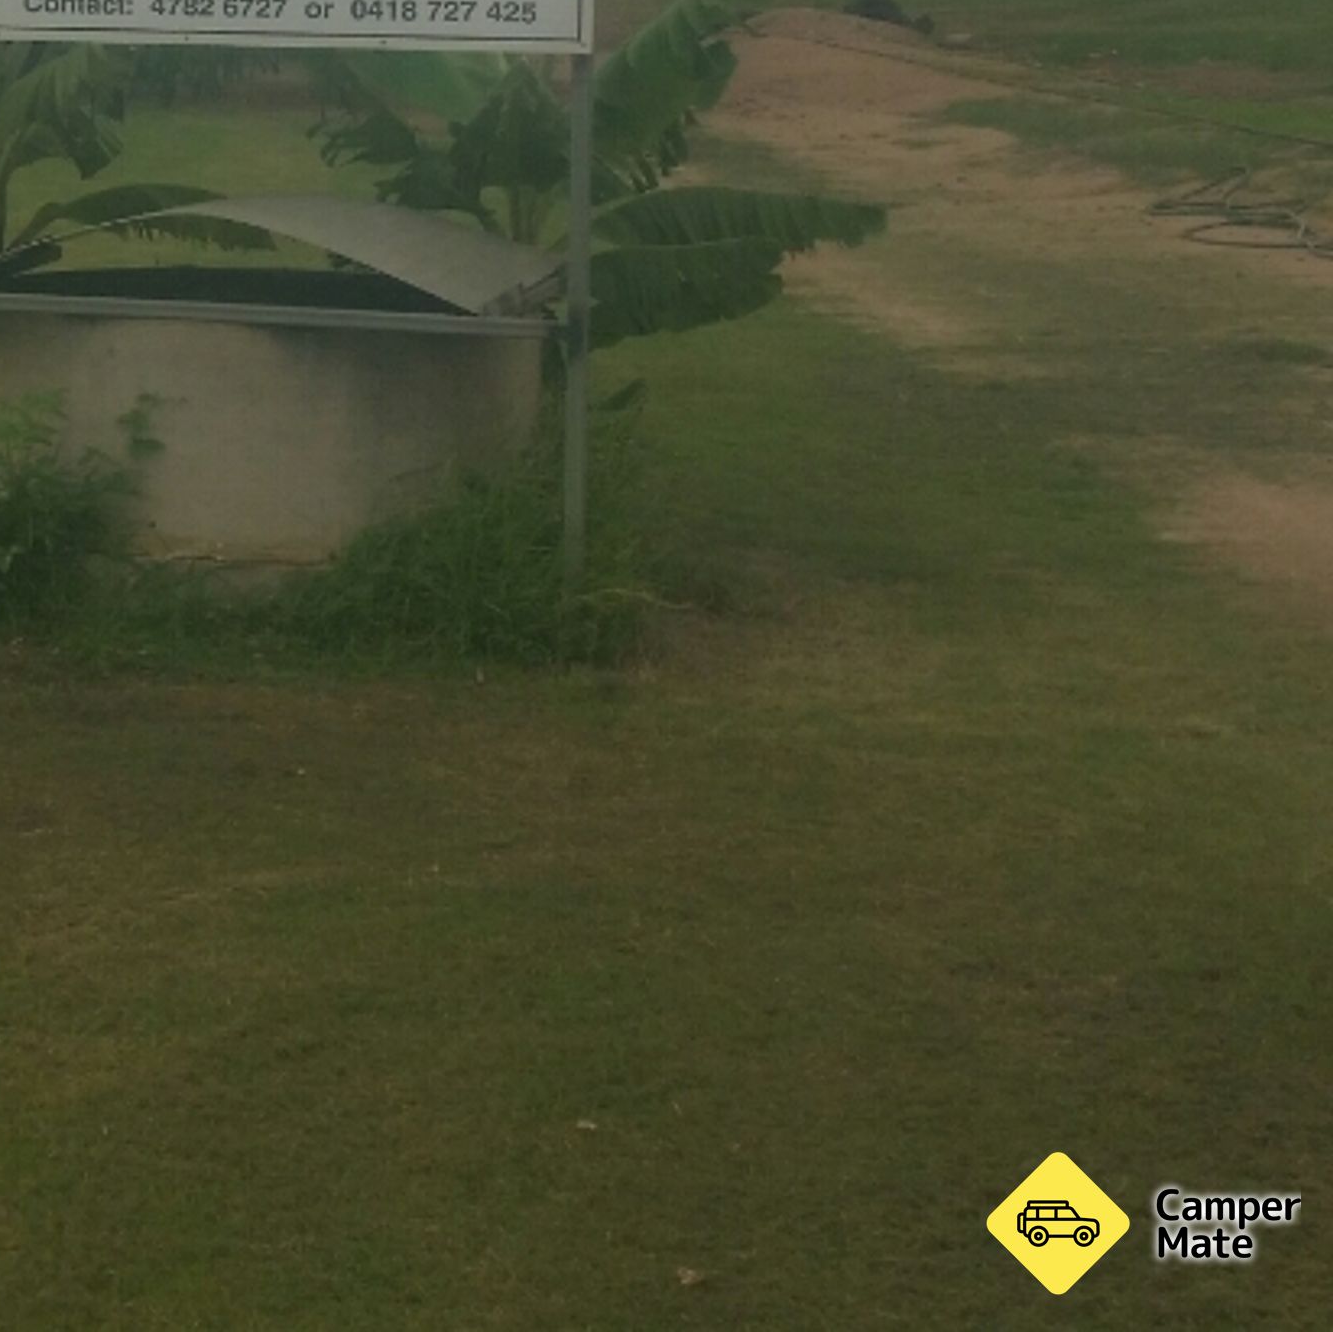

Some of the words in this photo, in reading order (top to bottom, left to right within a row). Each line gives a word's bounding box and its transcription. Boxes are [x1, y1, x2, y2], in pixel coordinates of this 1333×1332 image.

[303, 2, 335, 19] or
[427, 0, 478, 23] 727
[485, 0, 538, 25] 425
